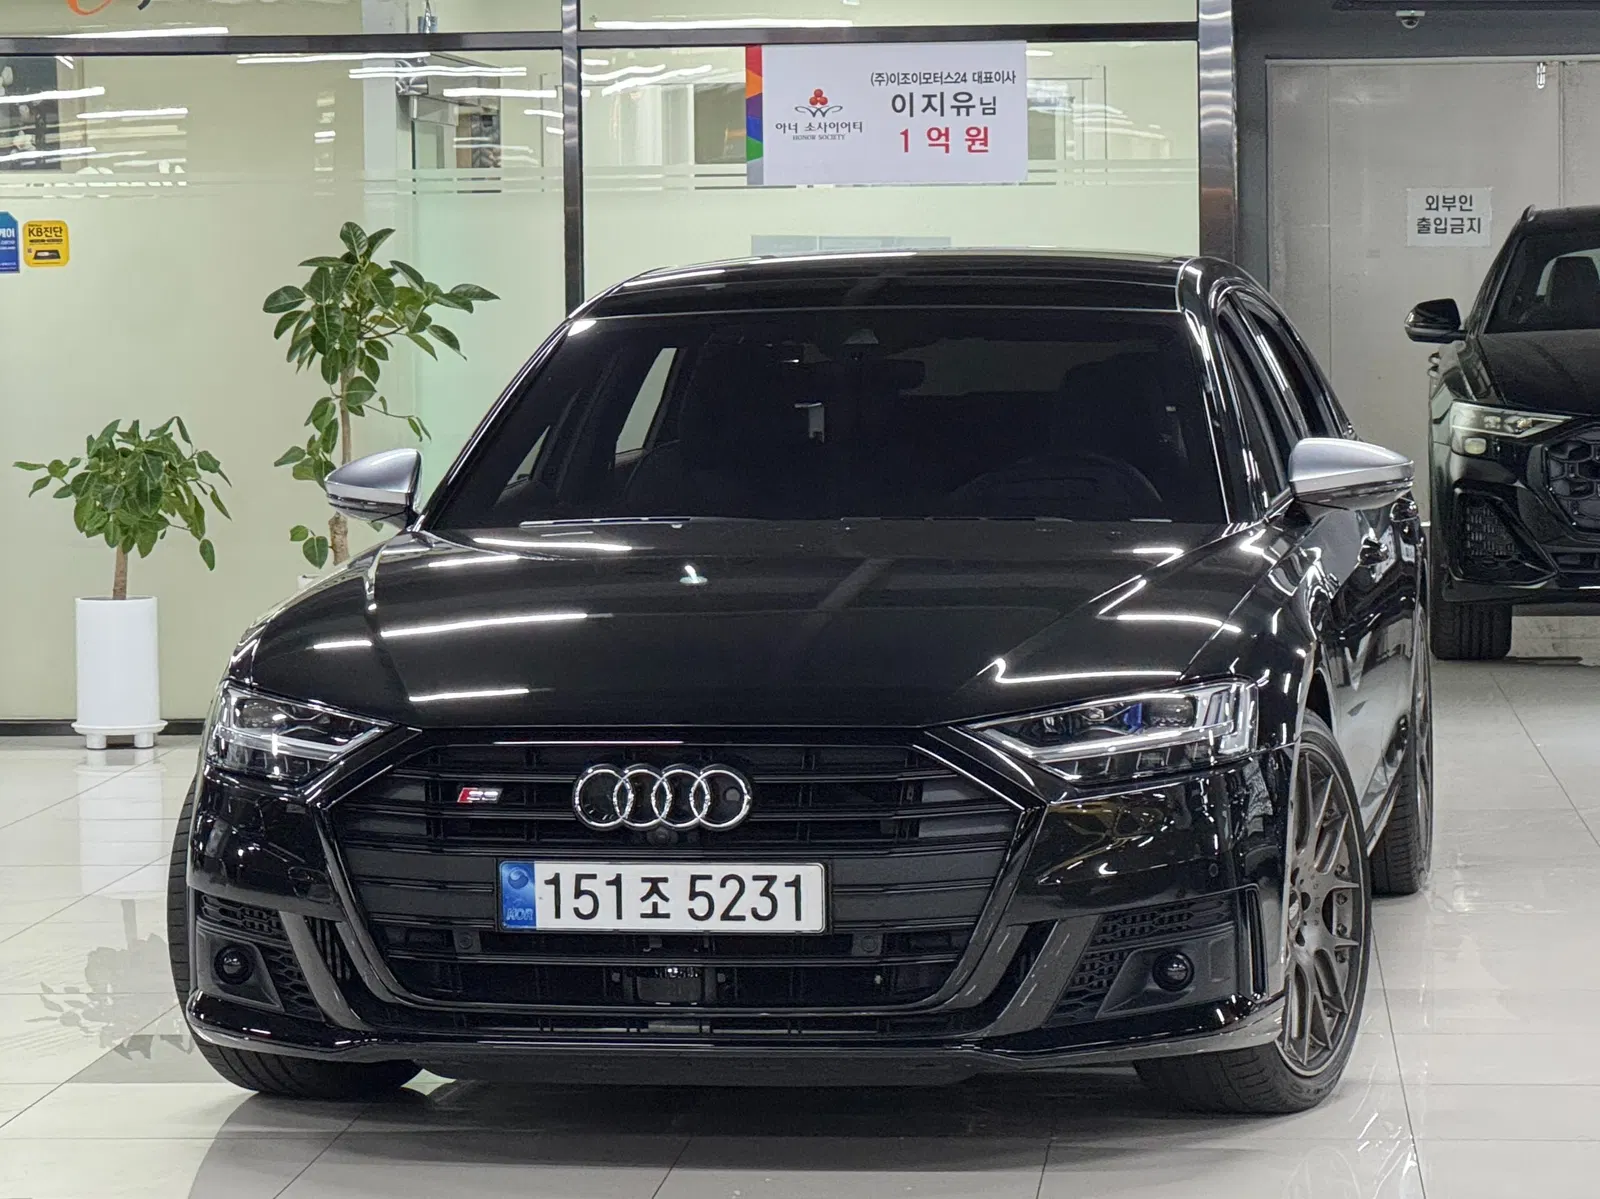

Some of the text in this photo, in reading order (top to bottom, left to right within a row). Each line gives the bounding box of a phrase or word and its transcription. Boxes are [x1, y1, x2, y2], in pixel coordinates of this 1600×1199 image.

[870, 70, 1016, 86] (주)이조이모터스24 대표이사
[775, 121, 863, 134] 아너 소사이어티
[1425, 194, 1473, 212] 외부인
[28, 226, 63, 237] KB진단
[1416, 217, 1481, 234] 출입금지
